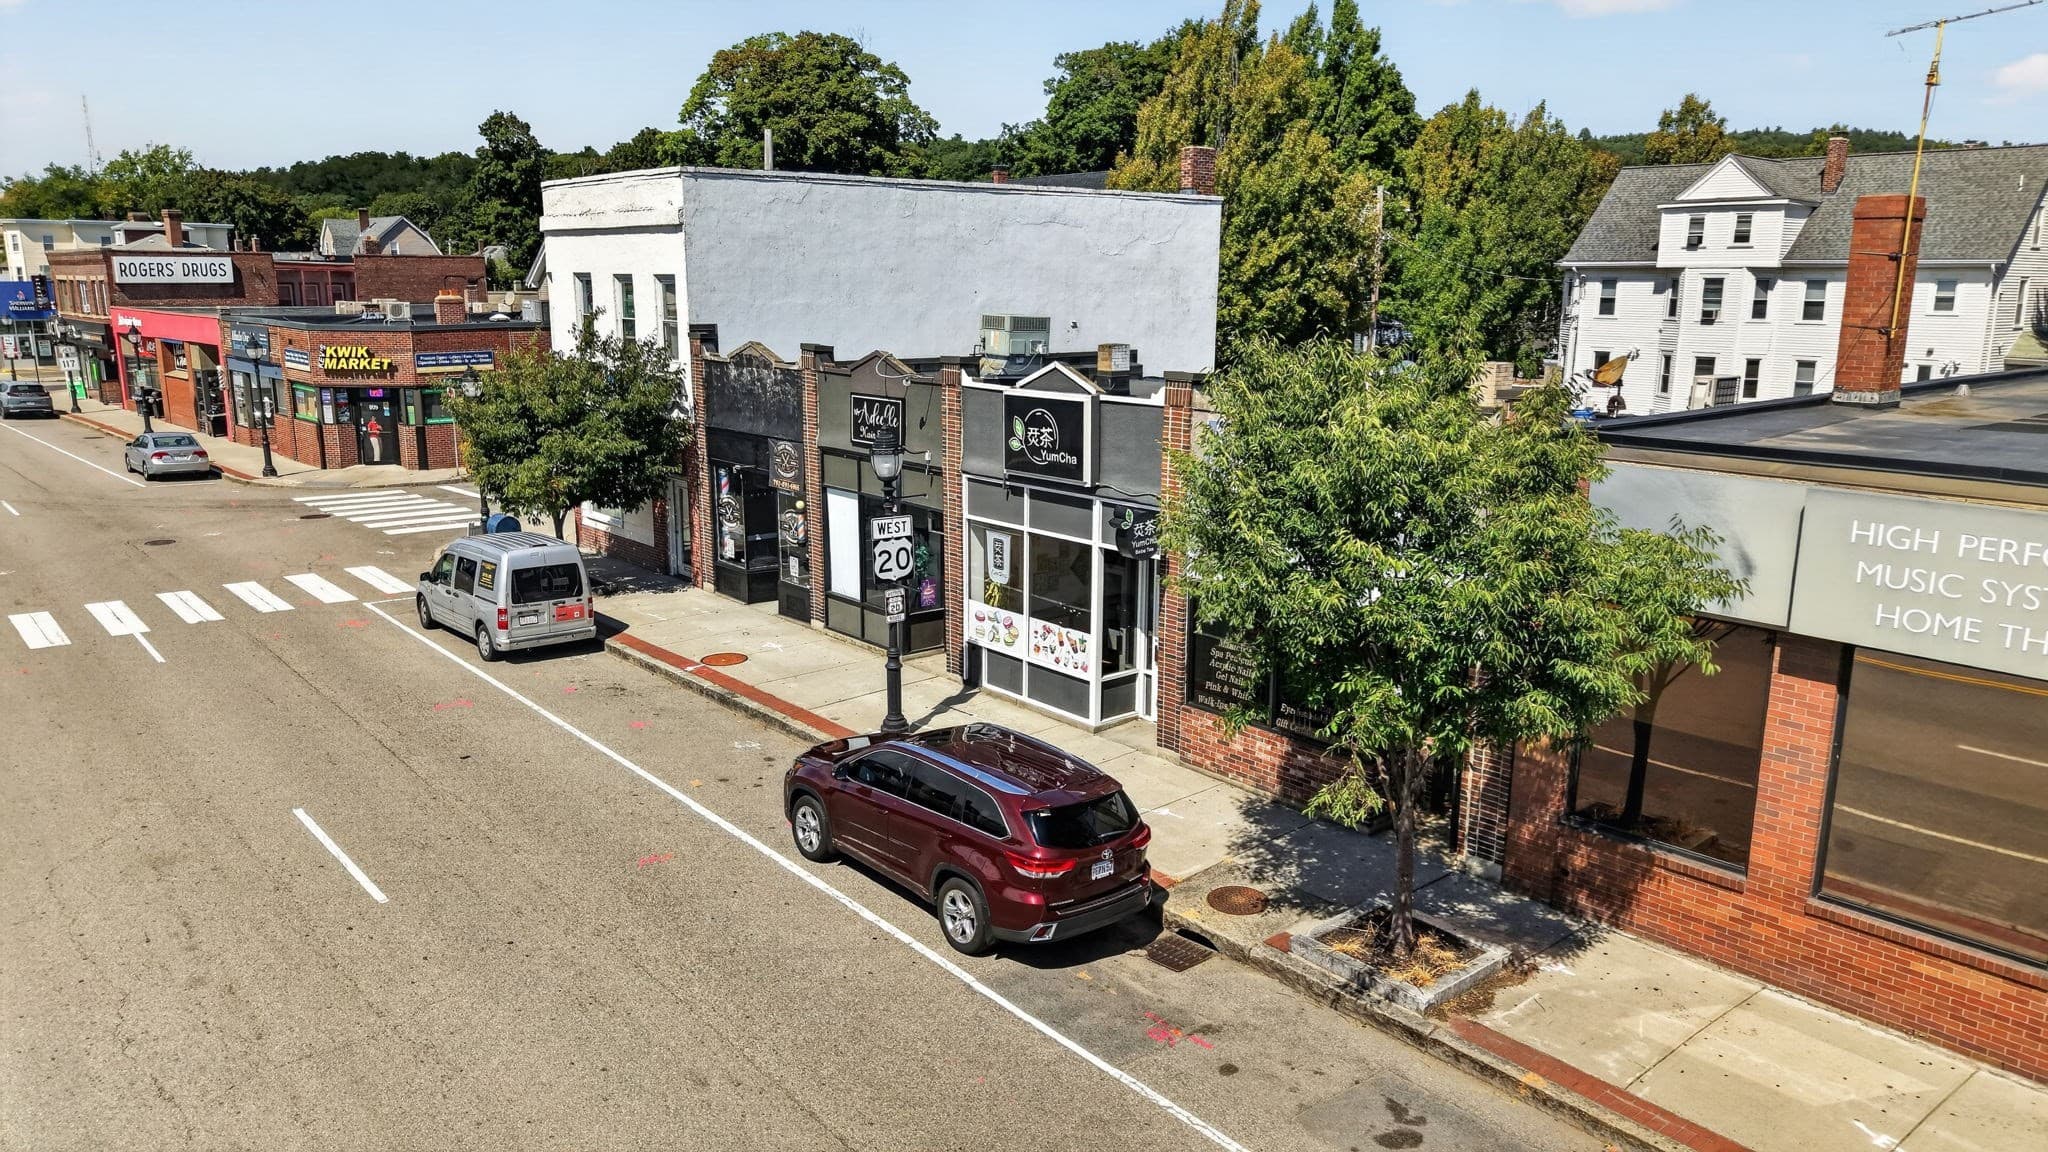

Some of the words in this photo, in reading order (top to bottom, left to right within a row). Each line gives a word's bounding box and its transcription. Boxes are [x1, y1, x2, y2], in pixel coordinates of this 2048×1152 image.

[182, 262, 227, 277] DRUGS
[325, 346, 369, 358] KWIK
[62, 359, 76, 369] 117
[323, 357, 392, 370] MARKET
[1041, 449, 1077, 465] YumCha
[877, 521, 907, 535] WEST
[1850, 519, 1940, 554] HIGH
[1958, 533, 2048, 567] PERF
[878, 547, 910, 574] 20
[1856, 560, 1967, 598] MUSIC
[1875, 603, 1983, 643] HOME
[1210, 647, 1223, 659] Spa
[1215, 670, 1228, 681] Gel
[1229, 674, 1245, 687] Nail
[1236, 666, 1253, 678] Nail
[1205, 681, 1222, 692] Pink
[1223, 685, 1229, 694] &
